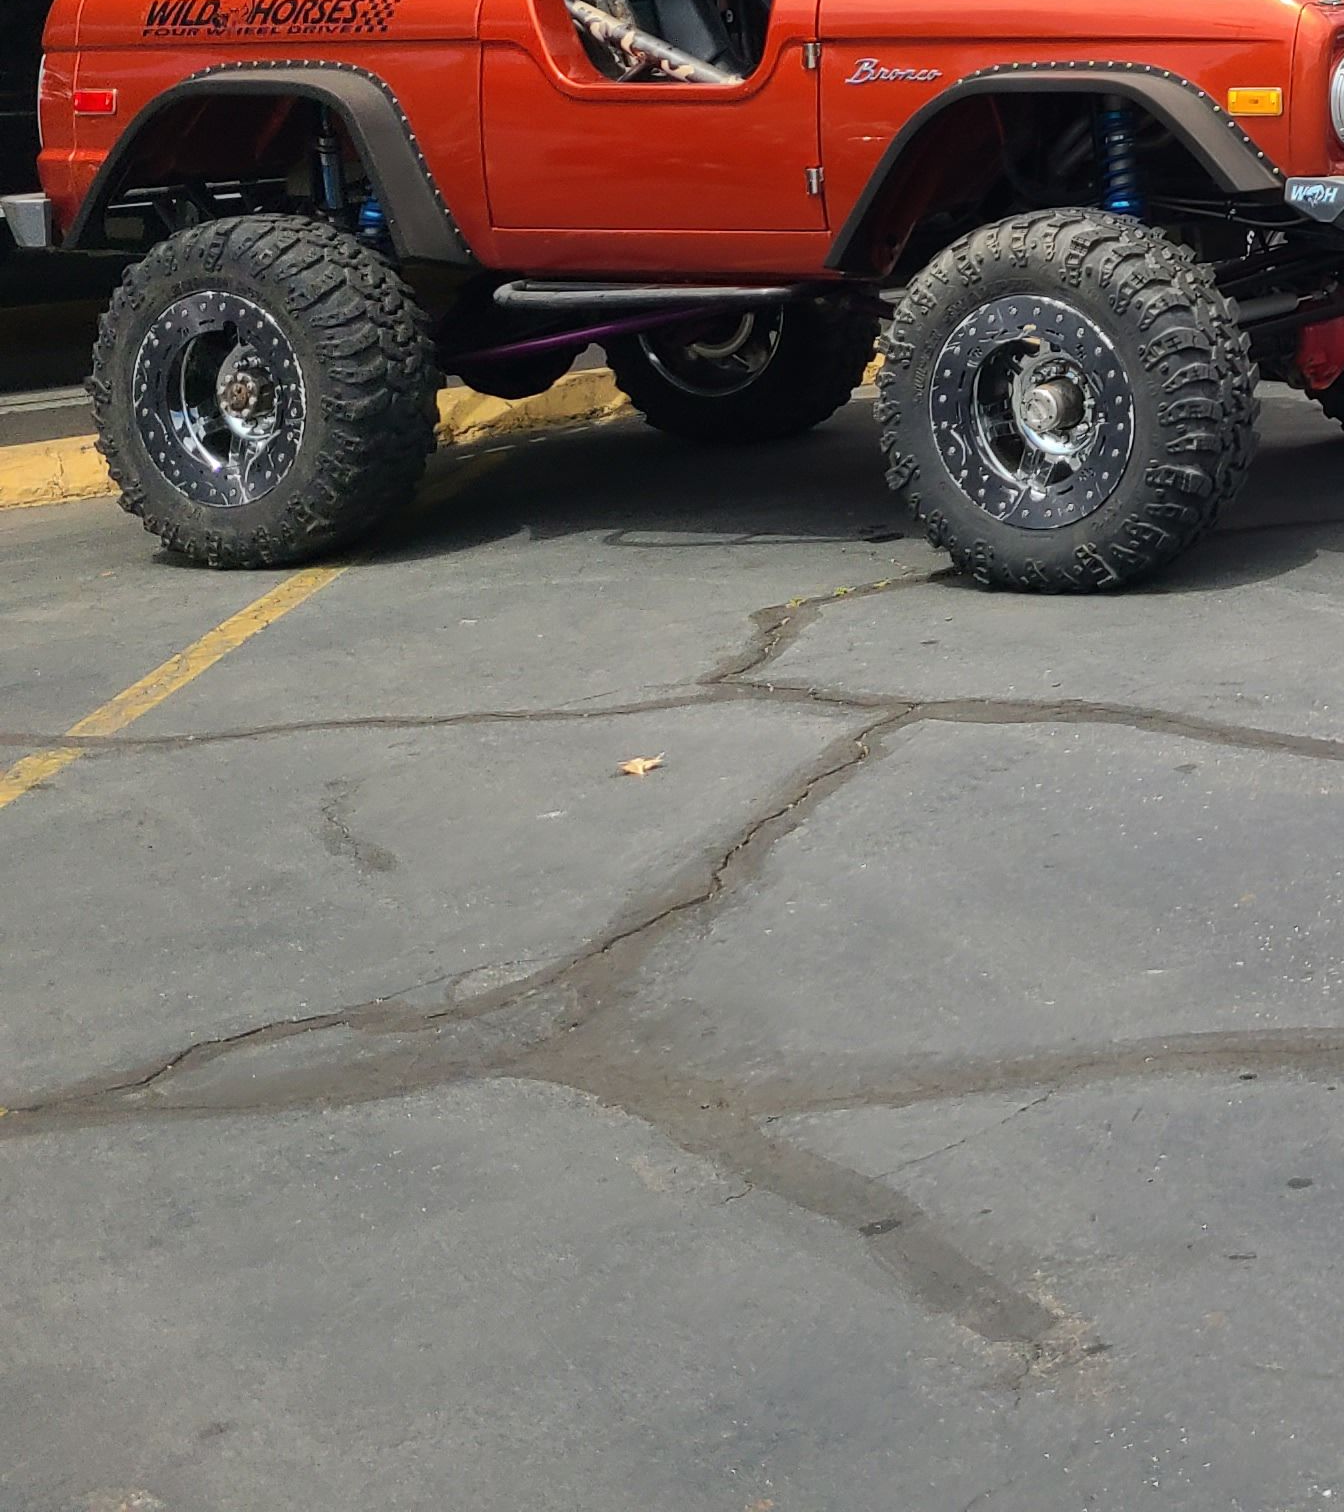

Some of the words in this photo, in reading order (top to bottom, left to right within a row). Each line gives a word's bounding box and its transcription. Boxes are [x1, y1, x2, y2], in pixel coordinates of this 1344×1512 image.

[146, 0, 221, 27] WILD
[142, 26, 199, 37] FOUR
[287, 24, 355, 35] DRIVE
[844, 57, 943, 85] Bronco
